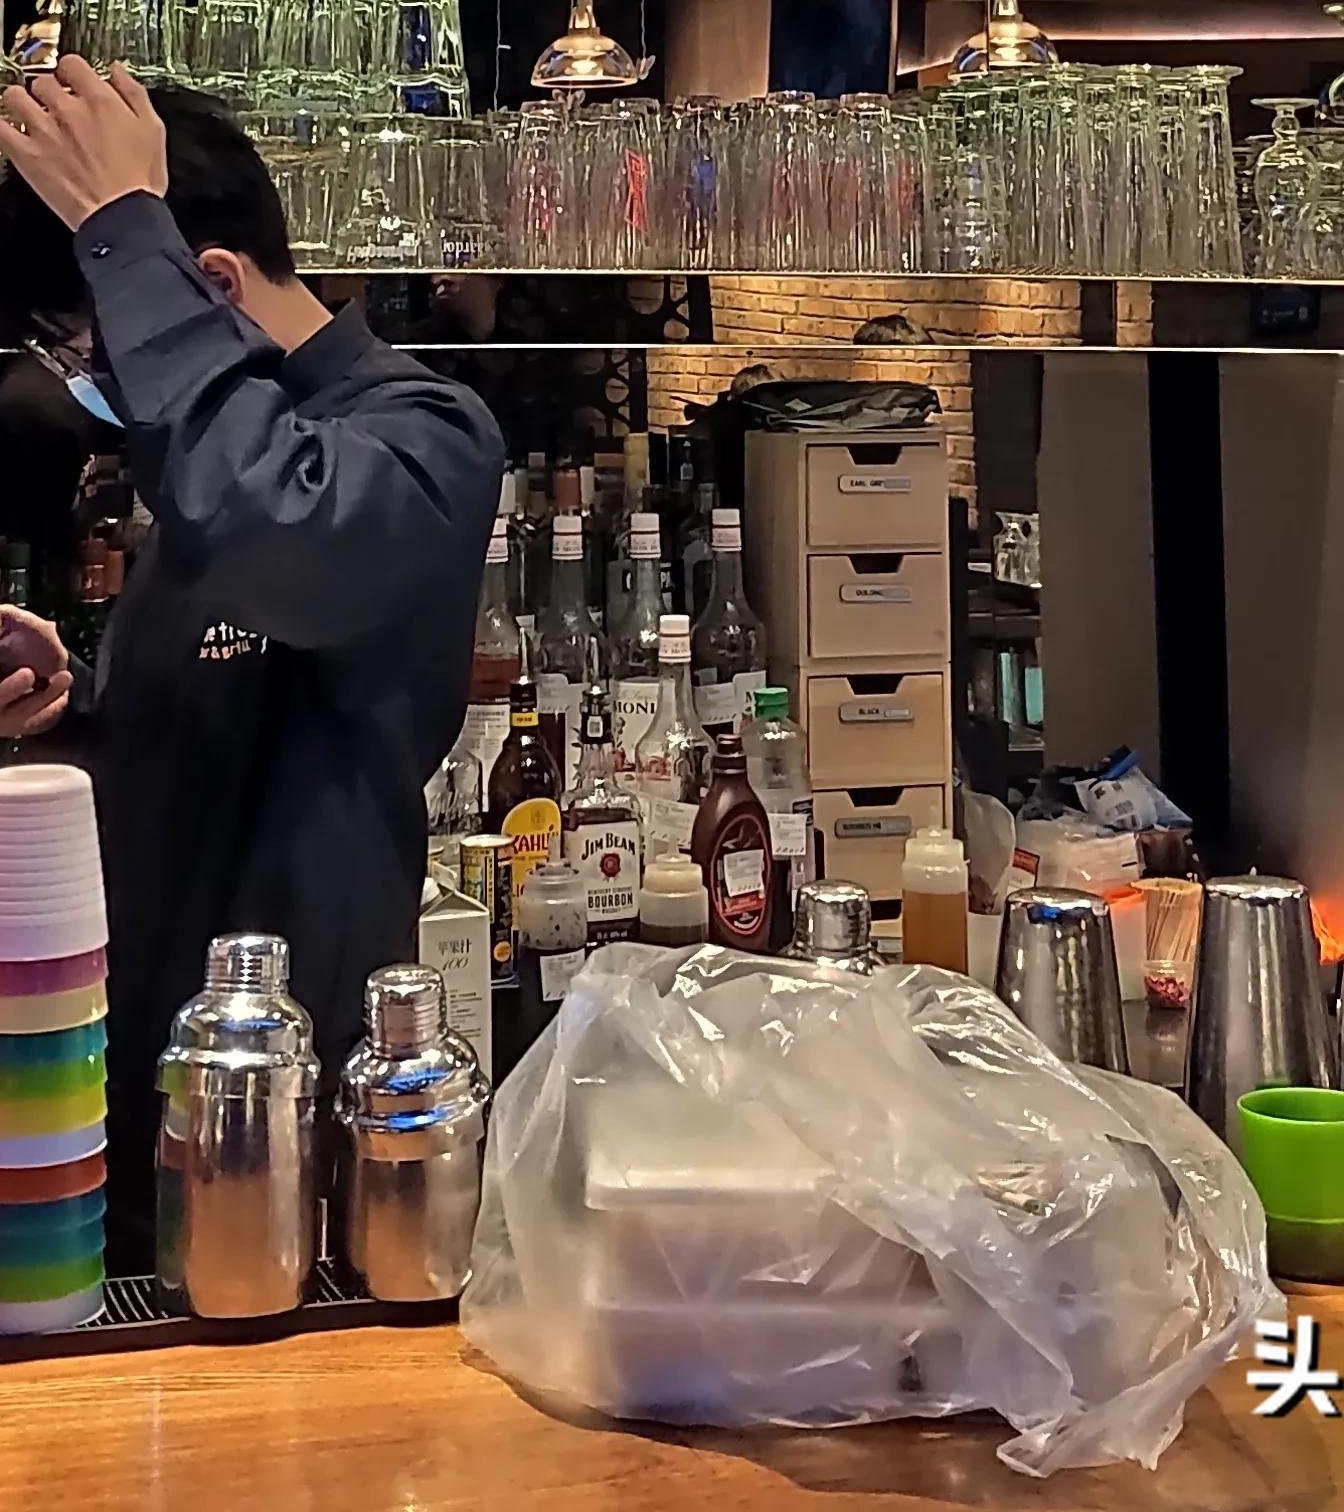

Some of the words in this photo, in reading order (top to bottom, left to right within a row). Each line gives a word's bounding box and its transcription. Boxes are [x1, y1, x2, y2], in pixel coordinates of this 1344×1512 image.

[581, 837, 605, 861] JIM
[606, 833, 636, 856] BEAM
[587, 892, 634, 909] BOURBON
